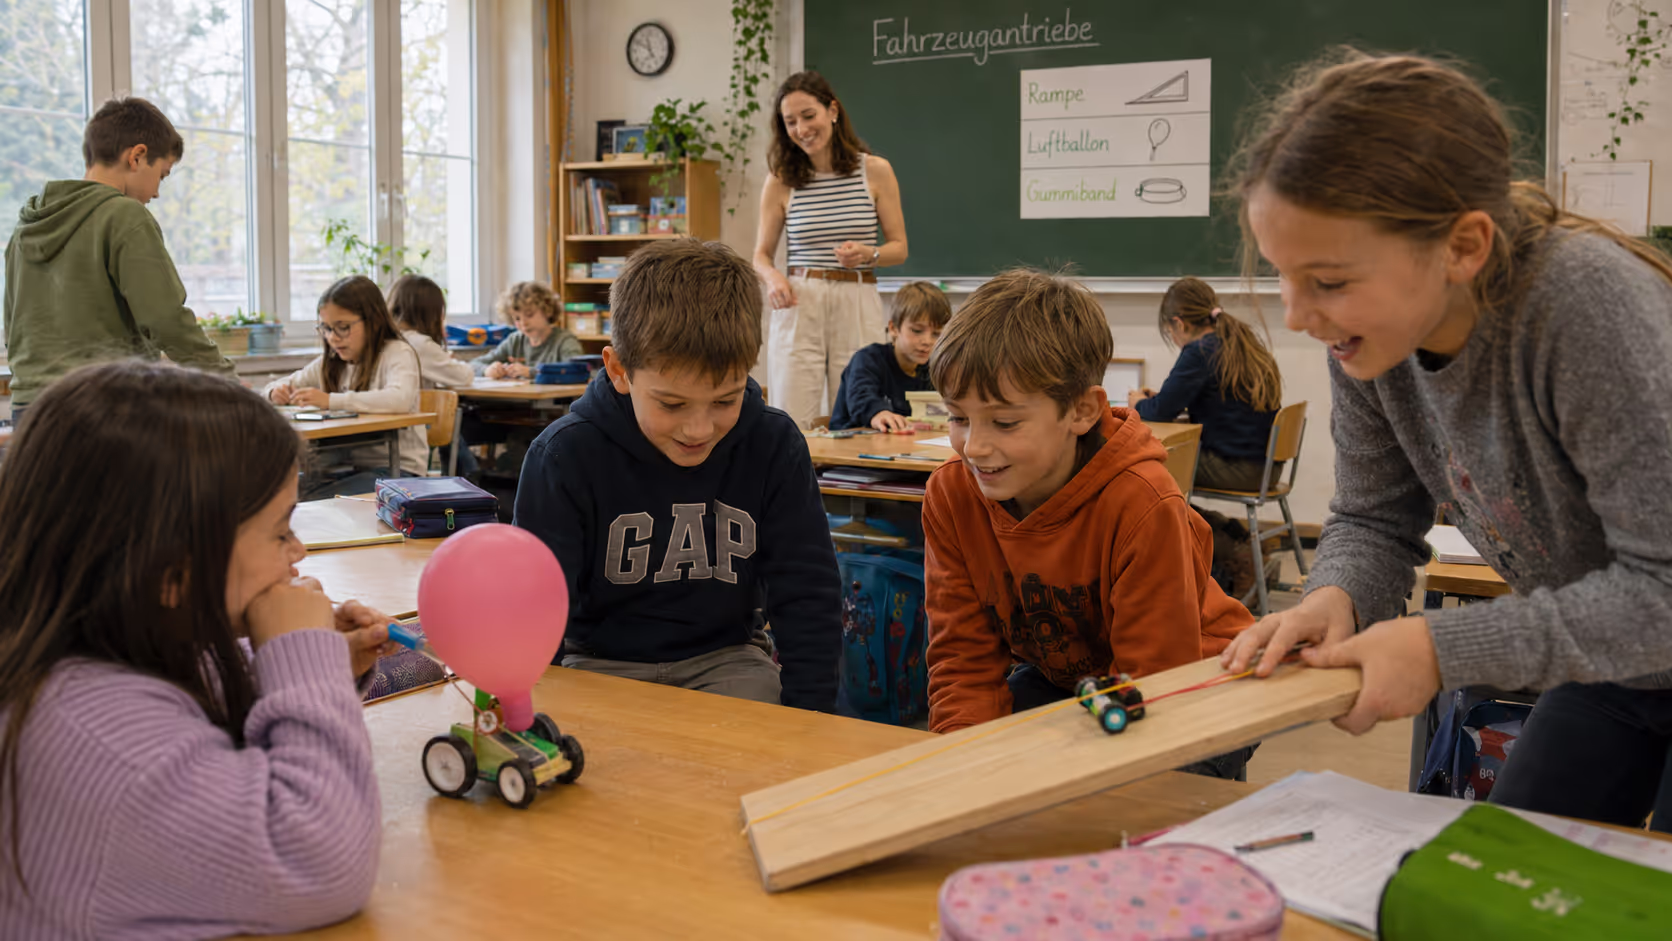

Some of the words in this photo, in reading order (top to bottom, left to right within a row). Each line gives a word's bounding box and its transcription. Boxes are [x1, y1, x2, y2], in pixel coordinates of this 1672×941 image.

[872, 8, 1094, 65] Fahrzeugantriebe
[1027, 82, 1085, 109] Rampe
[1027, 131, 1110, 157] Luftballon
[1026, 177, 1117, 203] Gummiband
[604, 498, 757, 584] GAP
